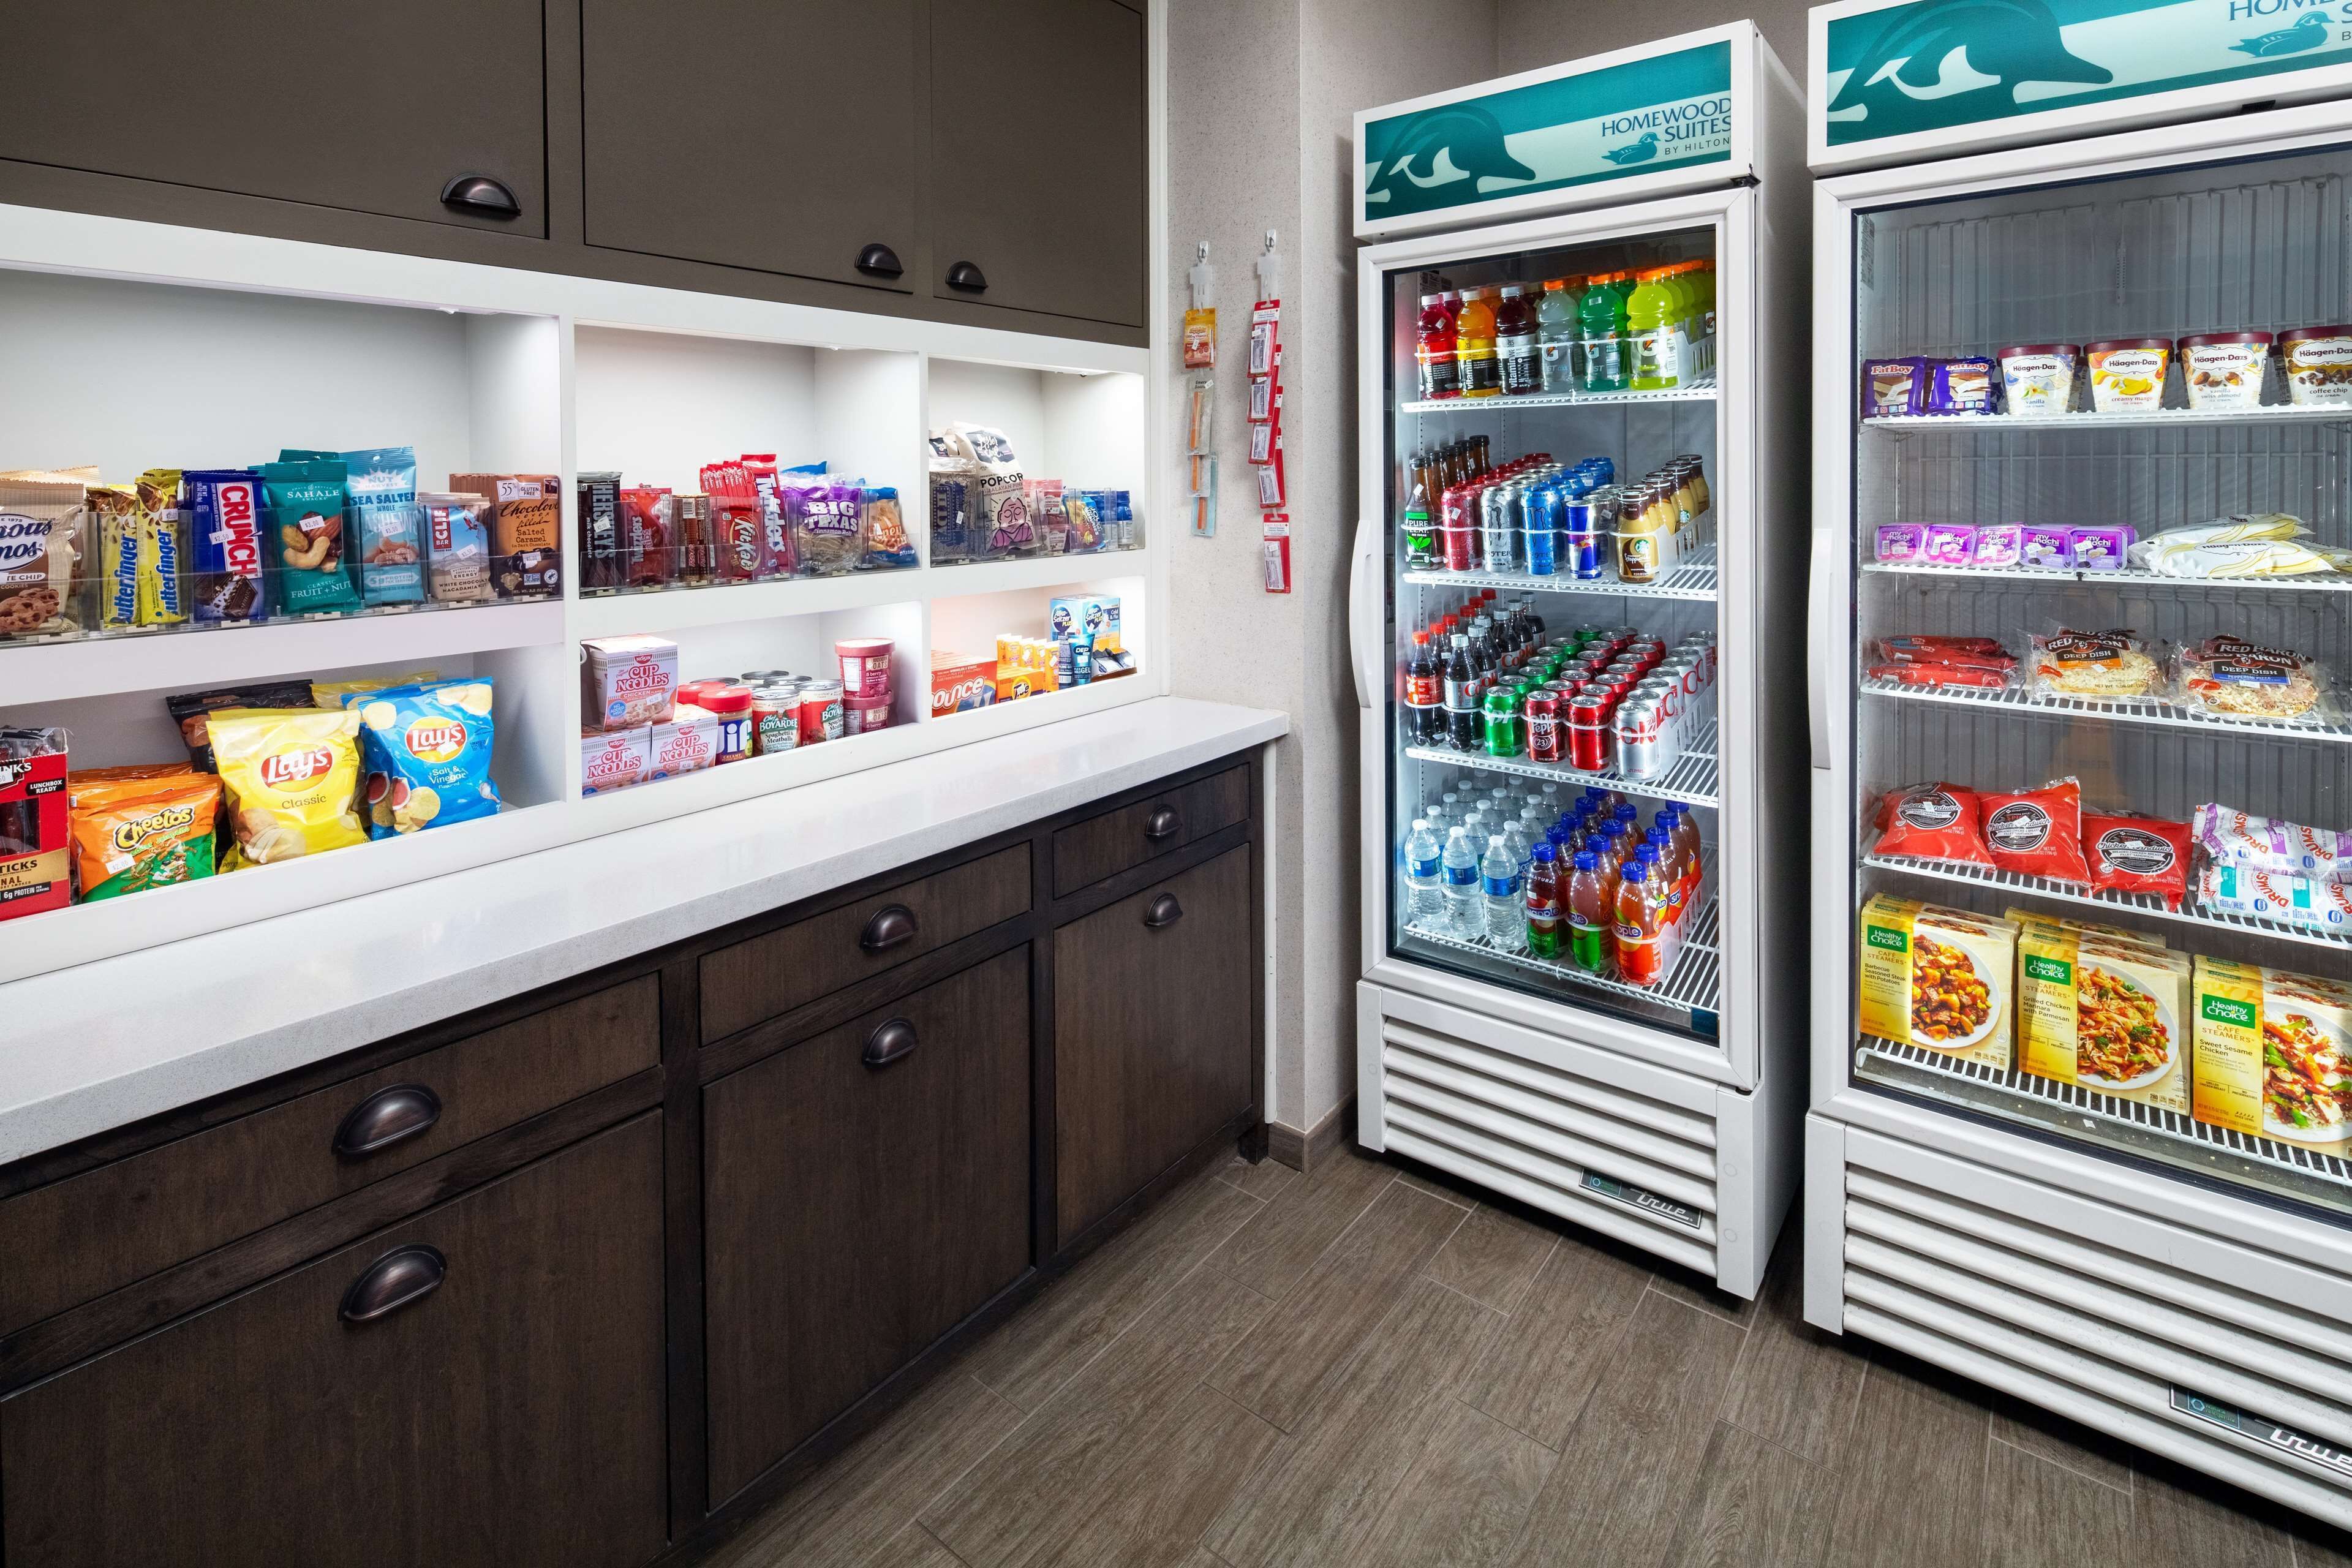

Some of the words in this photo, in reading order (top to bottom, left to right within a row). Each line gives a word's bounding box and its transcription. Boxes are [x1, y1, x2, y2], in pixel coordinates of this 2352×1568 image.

[1602, 97, 1731, 137] HOMEWOOD
[1664, 115, 1731, 142] SUITES
[1665, 146, 1679, 156] BY
[1685, 137, 1730, 152] HILTON
[2109, 358, 2158, 368] Häagen-Dazs
[2194, 353, 2248, 364] Häagen-Dazs
[1871, 364, 1914, 375] FatBoy
[2013, 363, 2059, 372] Häagen-Daz
[2331, 386, 2348, 395] chip
[287, 489, 339, 499] SAHALE
[352, 495, 374, 507] SEA
[376, 492, 415, 504] SALTED
[807, 500, 855, 516] BIG
[434, 508, 448, 540] CLIF
[516, 517, 550, 532] filled
[804, 513, 858, 532] TEXAS
[214, 533, 230, 542] $2.50
[221, 485, 258, 578] CRUNCH
[291, 587, 323, 598] FRUIT
[331, 580, 352, 591] NUT
[307, 579, 336, 589] CLASSIC
[1085, 612, 1102, 622] Seltzer
[2048, 637, 2072, 649] RED
[2220, 644, 2250, 653] RED
[629, 664, 659, 679] CUP
[616, 673, 669, 693] NOODLES
[623, 690, 650, 698] CHICKEN
[873, 712, 888, 721] OATS
[760, 718, 798, 732] BOYARDEE
[1531, 721, 1554, 735] Pepp
[412, 725, 462, 752] Lay's
[717, 719, 752, 755] Jif
[765, 729, 790, 739] Spaghetti
[671, 734, 700, 750] CUP
[766, 736, 793, 745] Meatballs
[660, 742, 709, 764] NOODLES
[268, 748, 330, 783] Lay's
[432, 766, 450, 777] Salt
[587, 756, 642, 778] NOODLES
[30, 779, 62, 790] LUNCHBOX
[429, 772, 466, 785] Vinegar
[595, 774, 622, 784] CHICKEN
[281, 794, 326, 810] Classic
[115, 807, 194, 850] Cheetos
[14, 887, 36, 896] PROTEIN
[1871, 935, 1902, 947] Choice
[1875, 930, 1901, 941] Healthy
[1867, 953, 1905, 965] STEAMERS
[1878, 950, 1896, 959] CAFÉ
[1864, 963, 1890, 972] Barbecue
[2029, 965, 2065, 979] Choice
[2034, 960, 2064, 973] Healthy
[1864, 968, 1890, 978] Seasoned
[1877, 976, 1901, 986] Potatoes
[2037, 982, 2059, 992] CAFÉ
[2025, 985, 2068, 1000] STEAMERS
[2023, 996, 2045, 1005] Grilled
[2046, 1001, 2071, 1011] Chicken
[2023, 1001, 2051, 1012] Marinara
[2212, 1000, 2247, 1014] Healthy
[2038, 1010, 2070, 1022] Parmesan
[2206, 1005, 2249, 1022] Choice
[2217, 1023, 2240, 1035] CAFÉ
[2201, 1027, 2251, 1044] STEAMERS
[2199, 1039, 2222, 1049] Sweet
[2224, 1043, 2253, 1056] Sesame
[2199, 1045, 2229, 1057] Chicken
